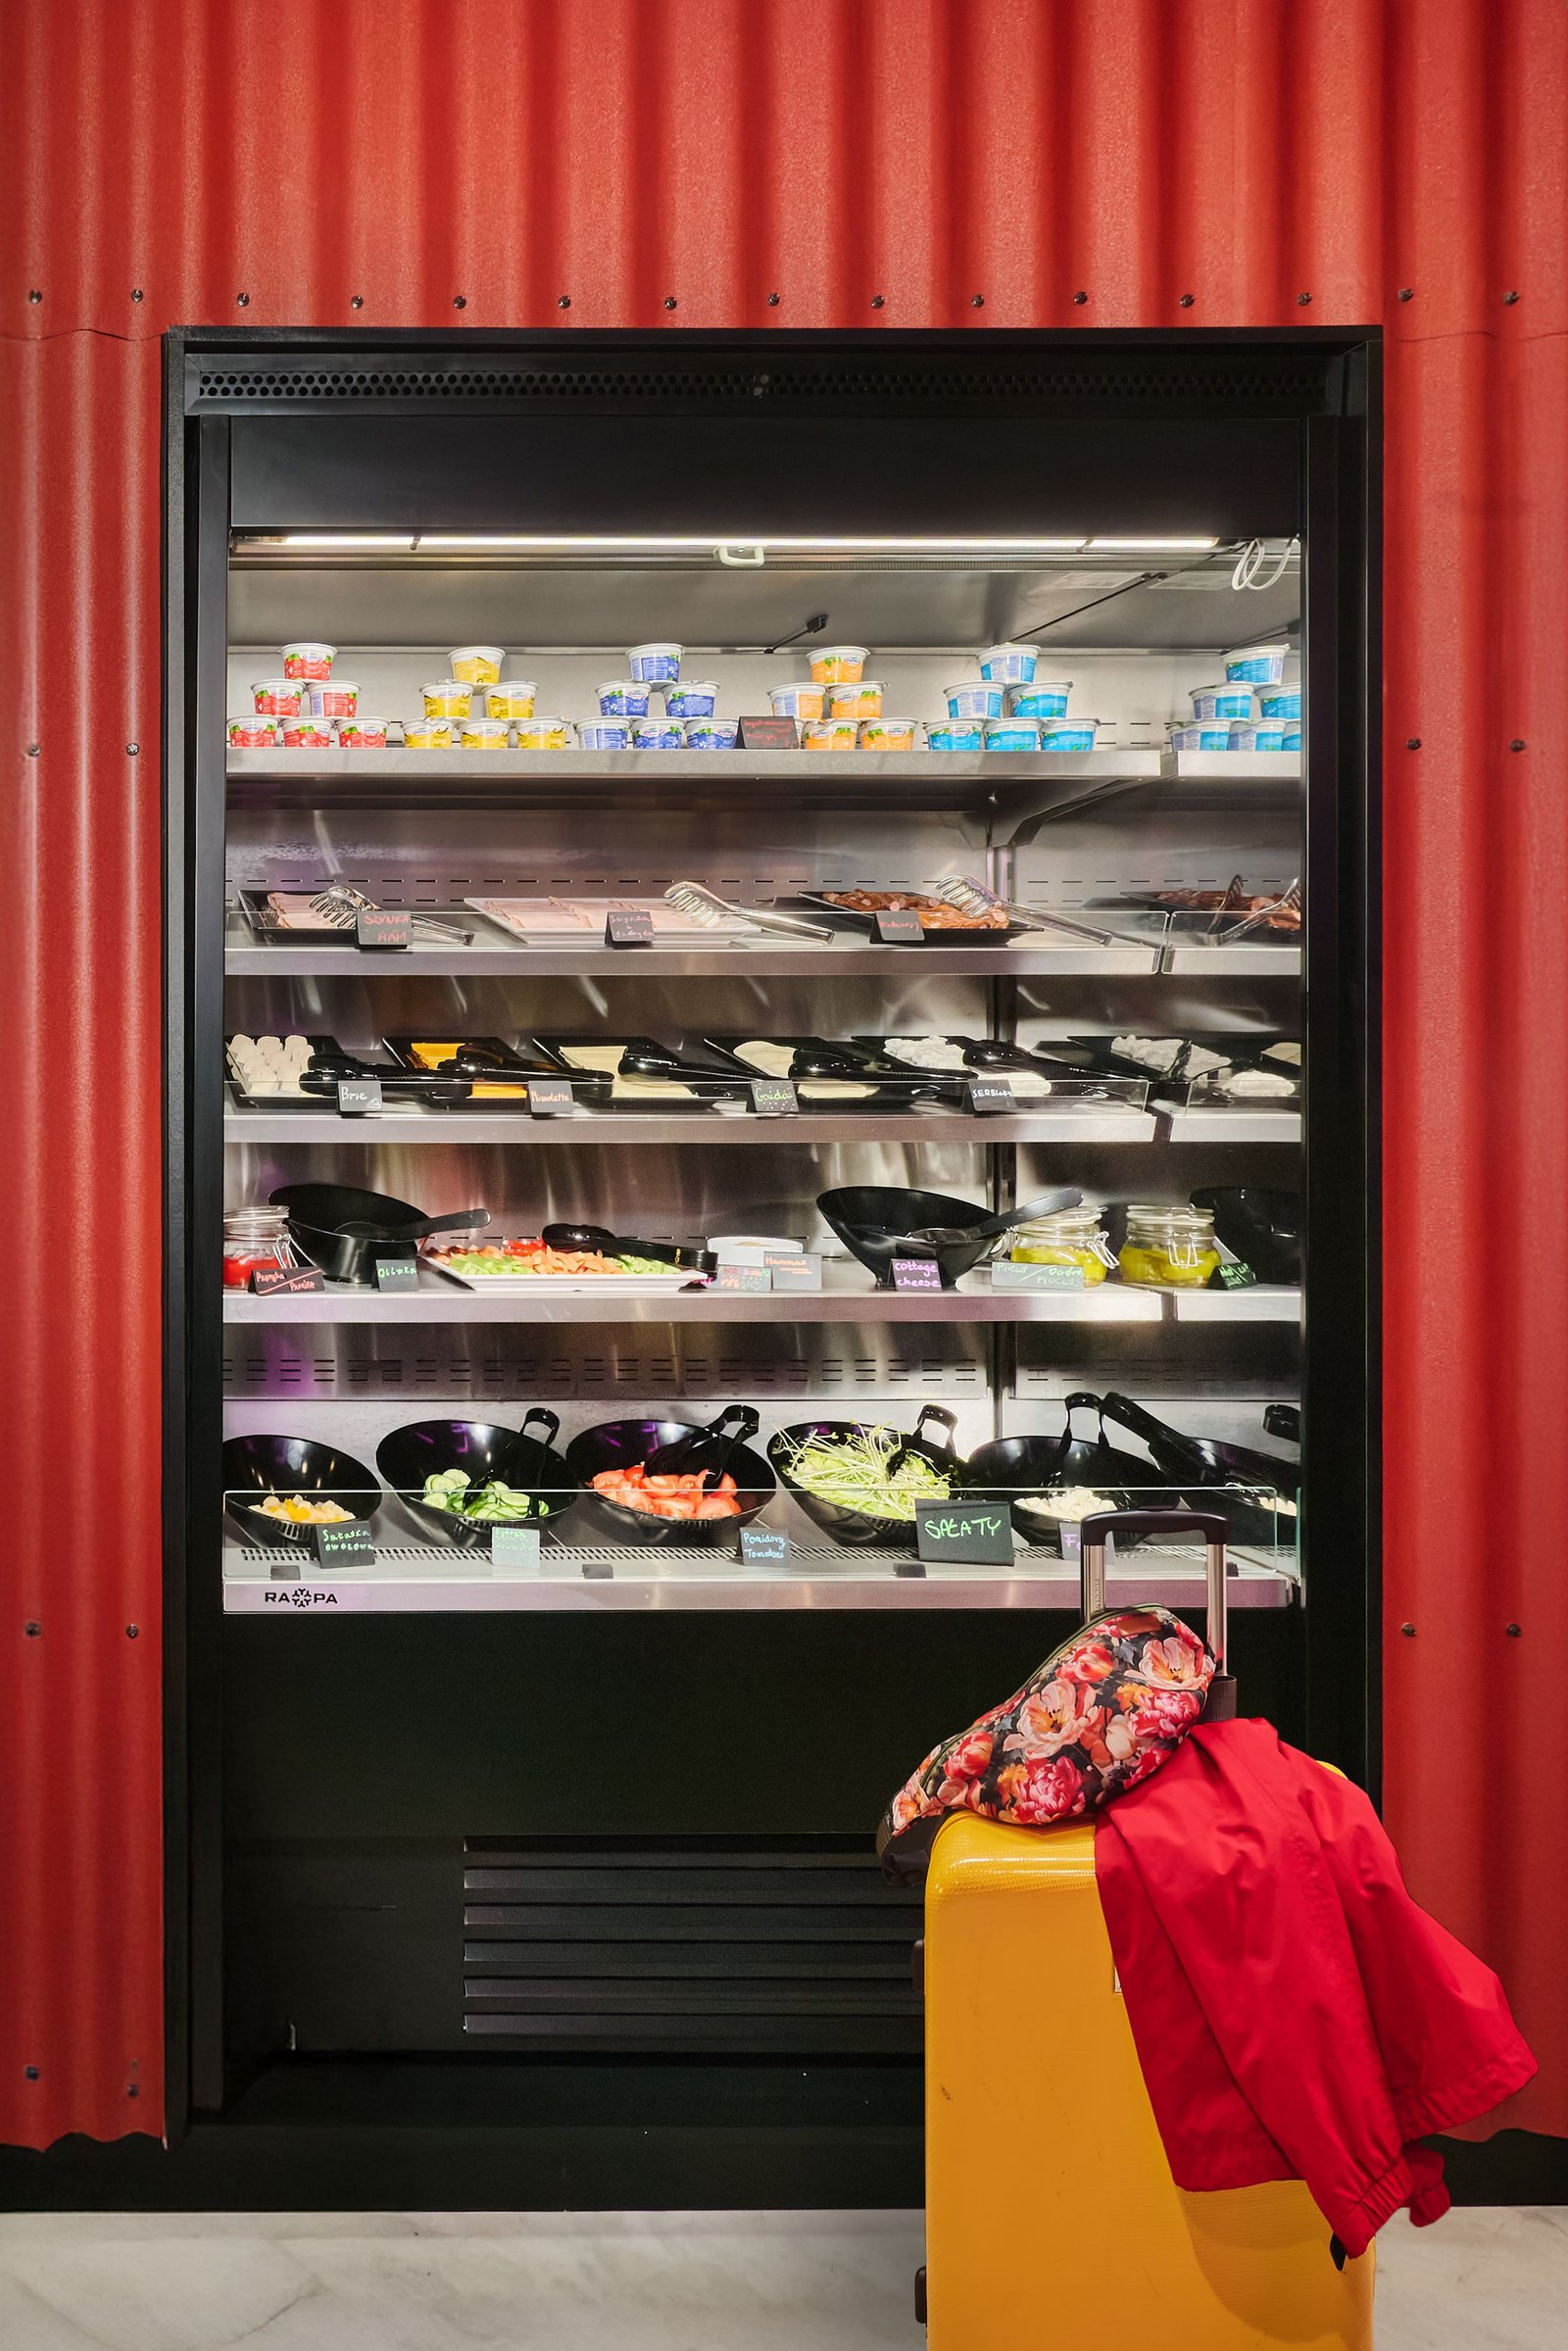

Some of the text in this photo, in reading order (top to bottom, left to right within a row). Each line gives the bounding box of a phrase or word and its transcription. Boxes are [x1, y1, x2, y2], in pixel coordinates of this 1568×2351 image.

[341, 1086, 368, 1102] Brie
[755, 1087, 793, 1102] Gouda
[894, 1260, 938, 1278] cottage
[896, 1276, 942, 1288] cheese
[743, 1532, 786, 1550] Pomidory
